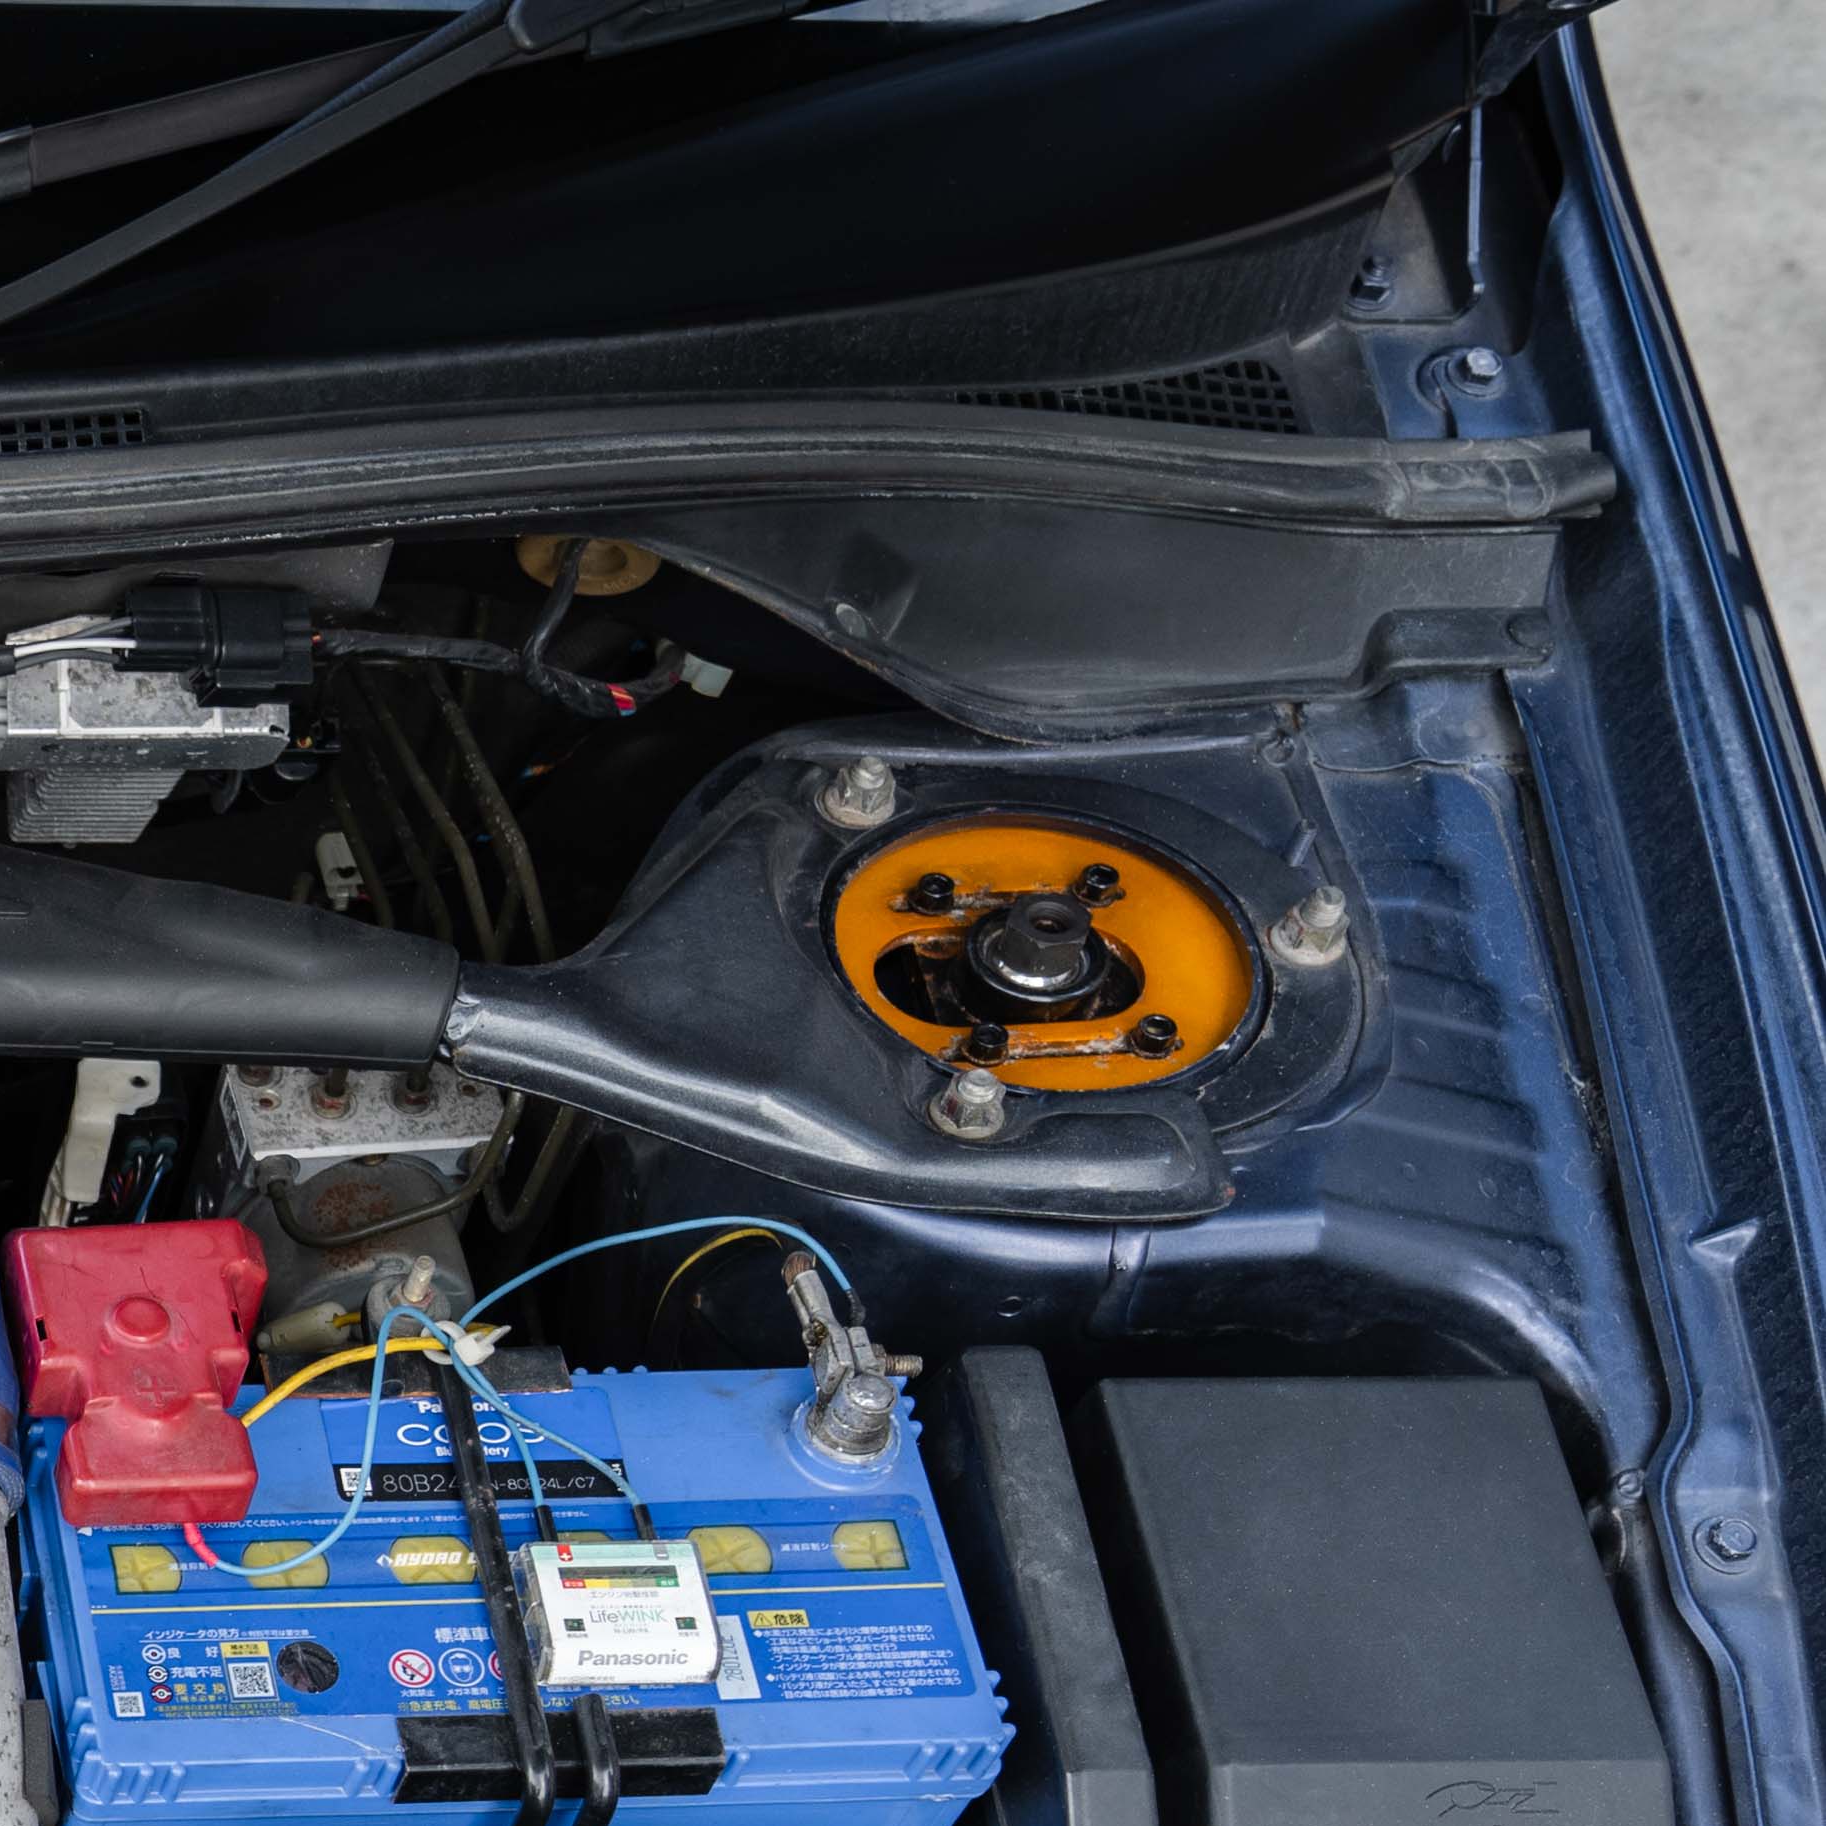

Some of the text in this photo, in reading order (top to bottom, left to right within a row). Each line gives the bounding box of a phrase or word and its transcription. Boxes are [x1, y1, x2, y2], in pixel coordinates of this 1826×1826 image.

[588, 1608, 669, 1624] LifeWINK
[774, 1613, 806, 1626] 危険
[578, 1648, 690, 1667] Panasonic
